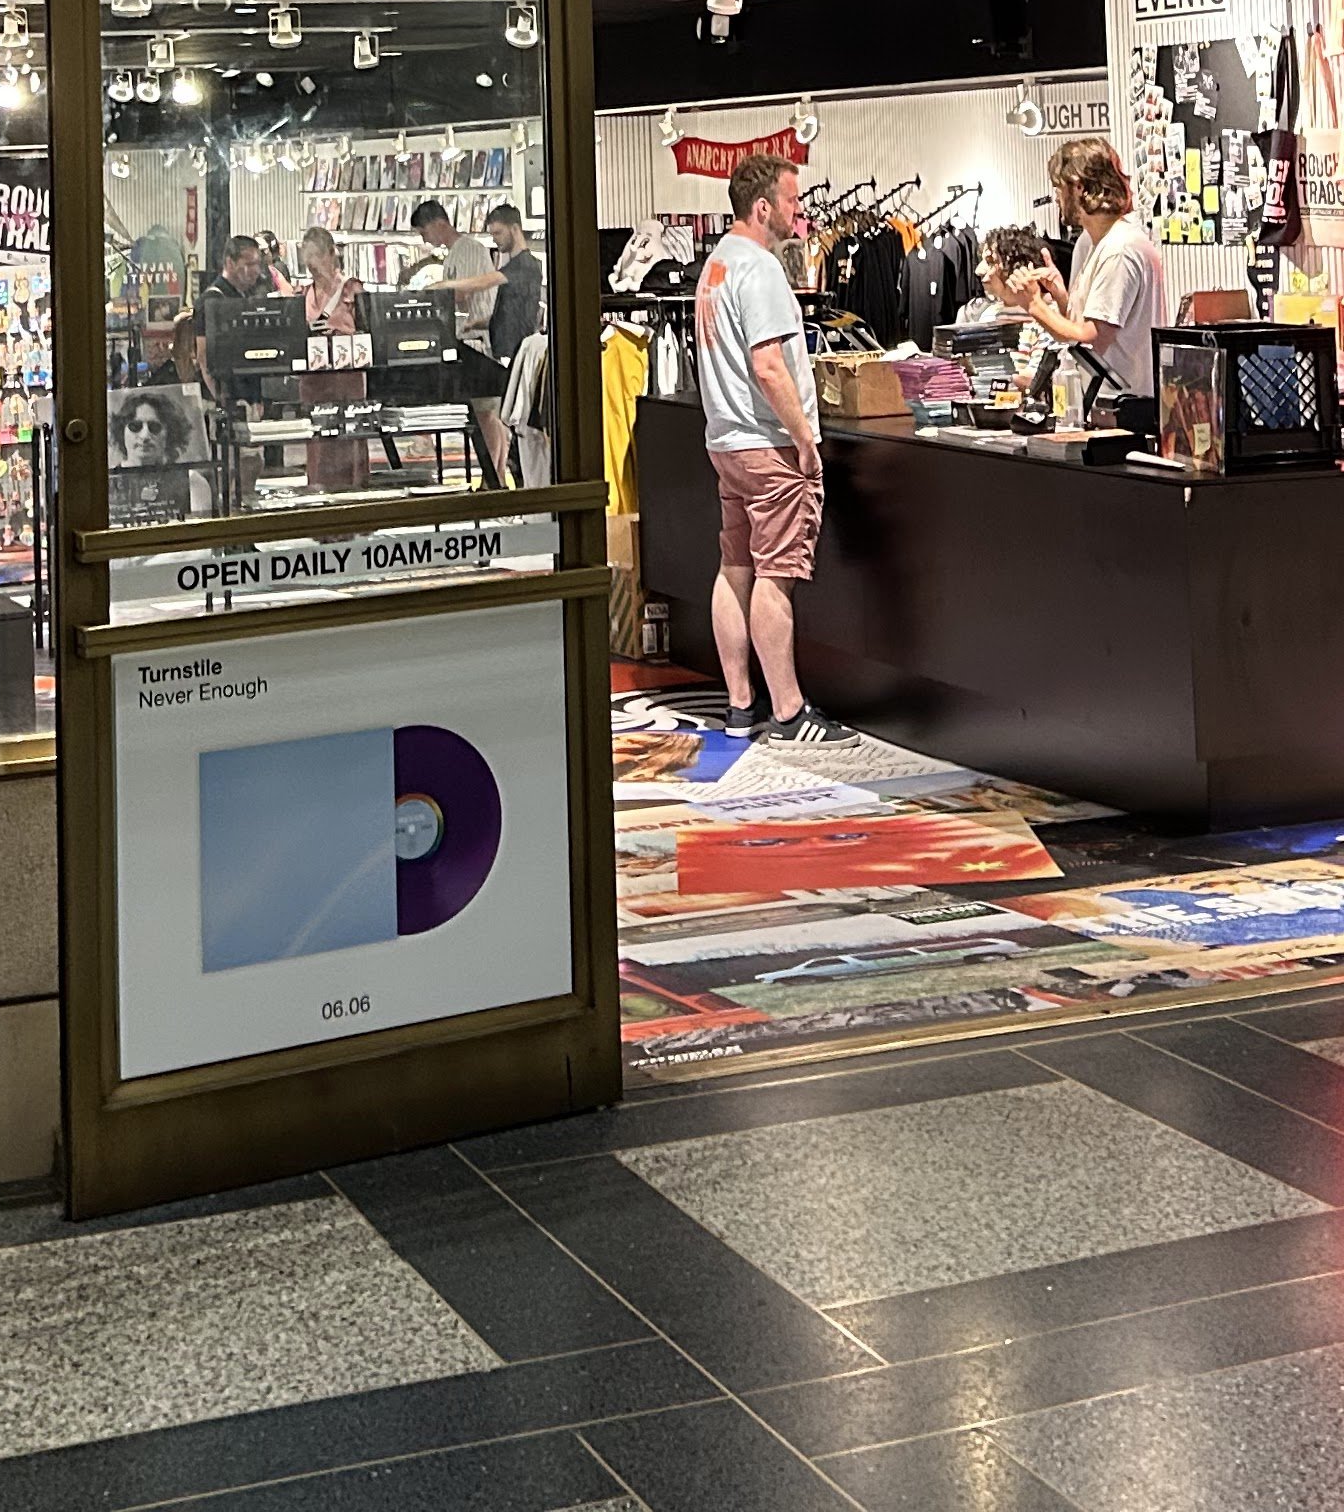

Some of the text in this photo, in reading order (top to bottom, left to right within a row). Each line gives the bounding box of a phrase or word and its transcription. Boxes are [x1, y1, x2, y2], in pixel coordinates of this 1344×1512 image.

[686, 143, 735, 176] ANARCHY
[177, 532, 502, 591] OPEN DAILY 10AM-8PM
[138, 658, 223, 685] Turnstile
[138, 676, 269, 709] Never Enough
[321, 994, 372, 1022] 06.06
